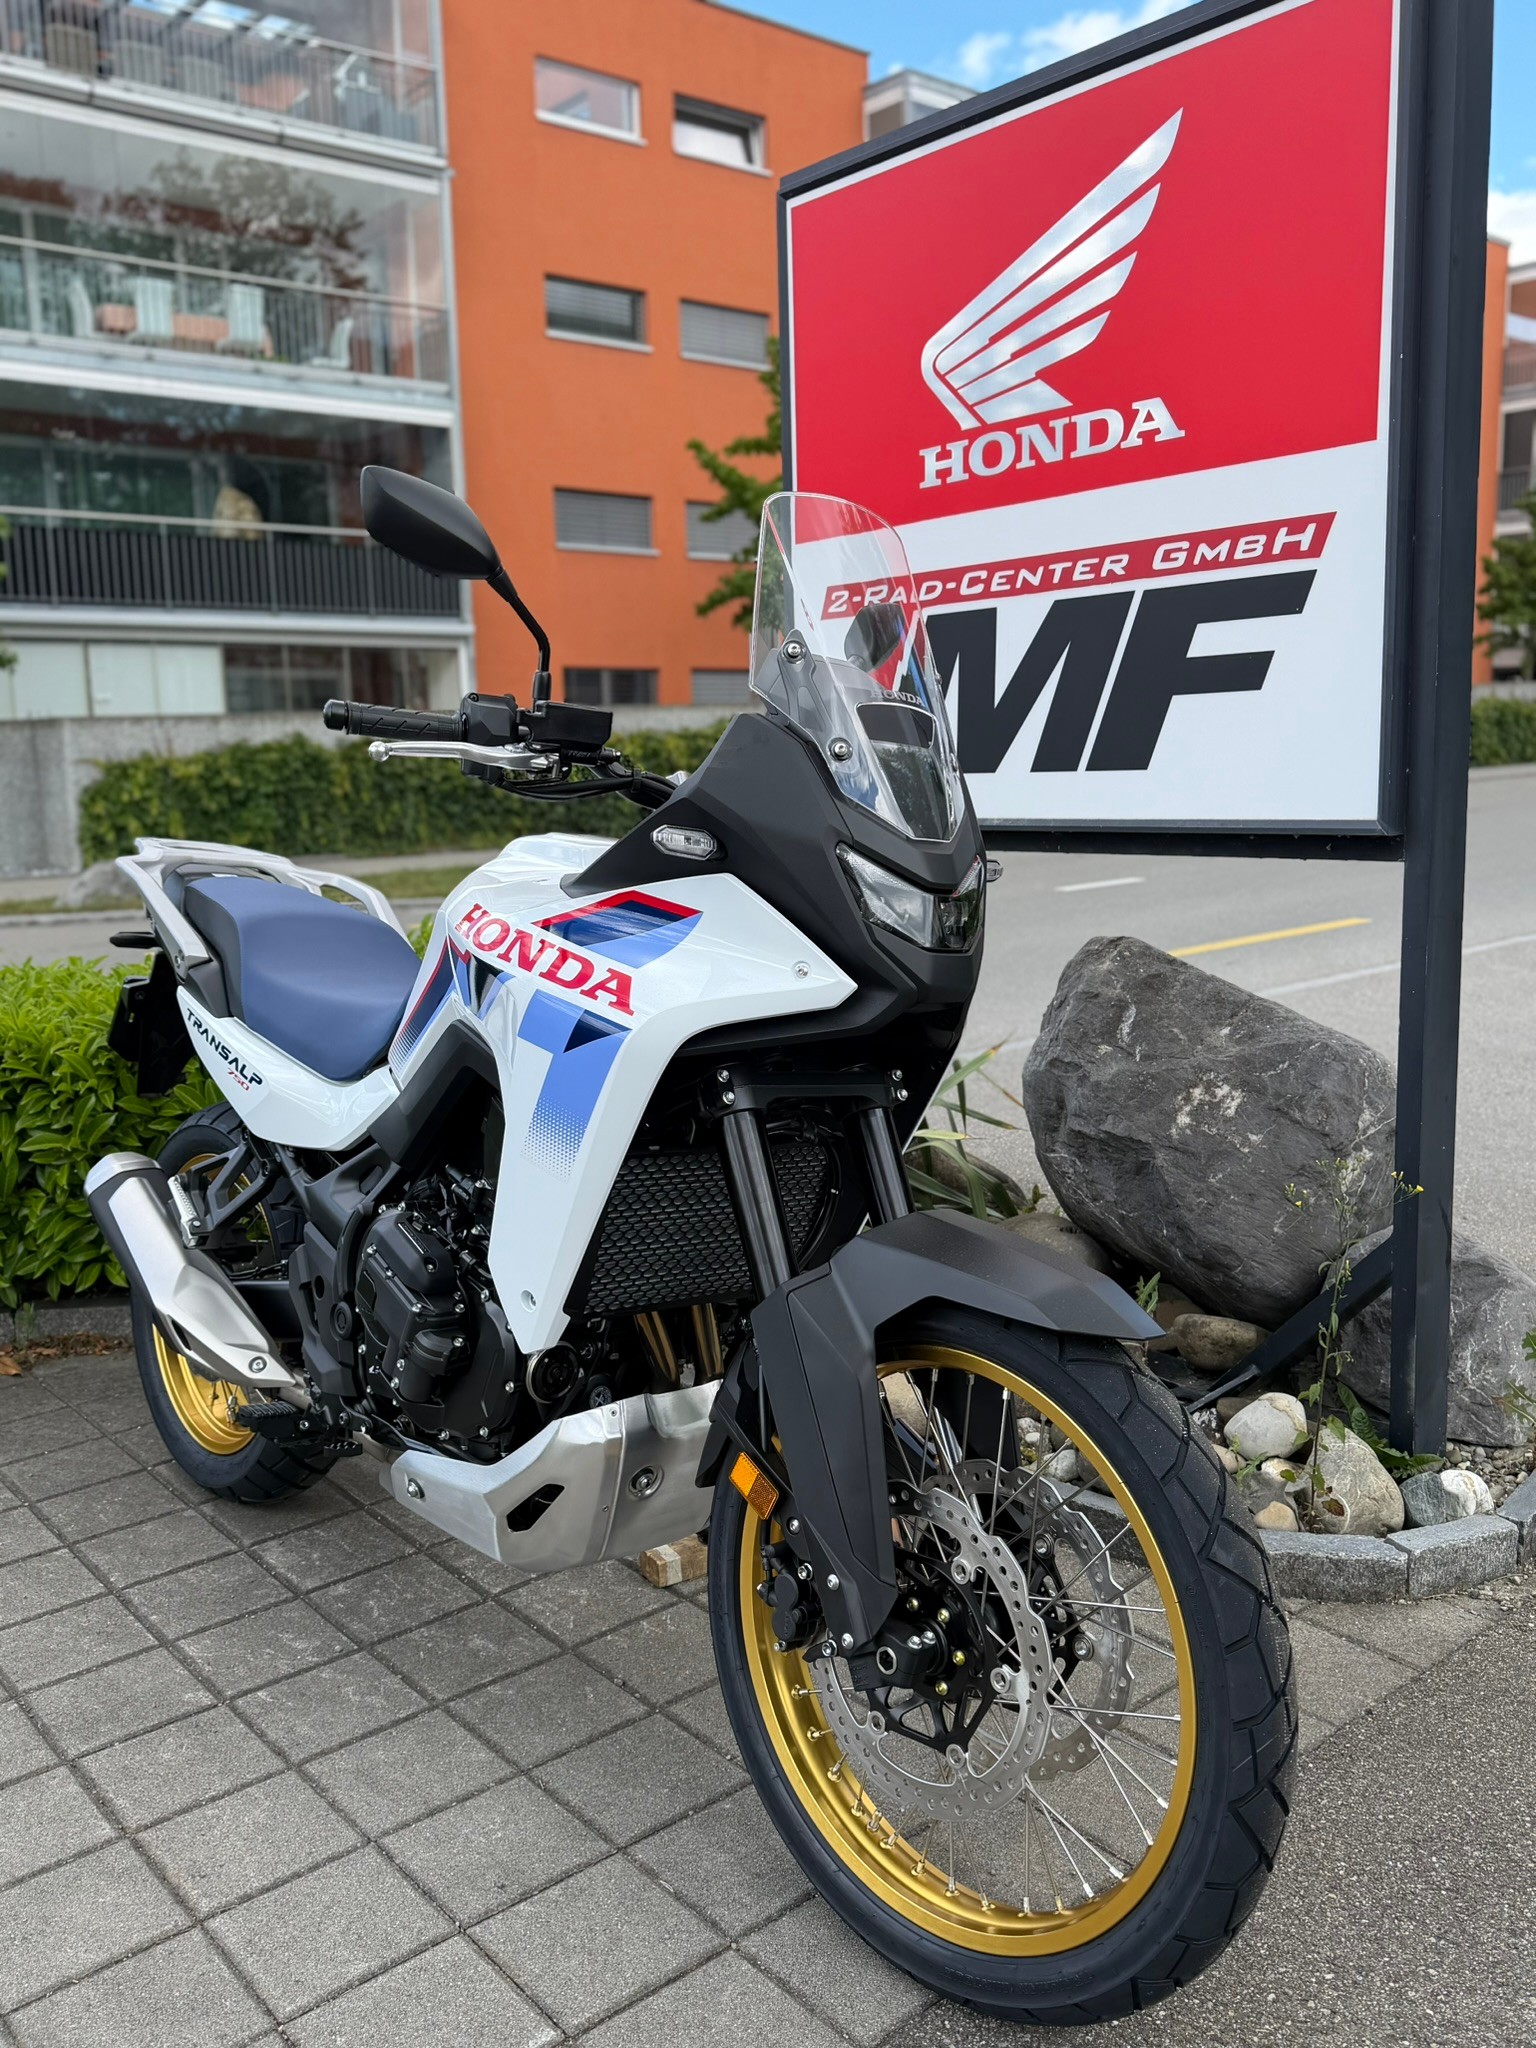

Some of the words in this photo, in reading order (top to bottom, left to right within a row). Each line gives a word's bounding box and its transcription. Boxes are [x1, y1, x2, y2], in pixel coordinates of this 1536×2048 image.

[919, 397, 1185, 489] HONDA
[870, 689, 926, 707] HONDA
[915, 569, 1317, 774] MF
[455, 903, 634, 1016] HONDA
[187, 1008, 263, 1085] TRANSALP
[227, 1068, 250, 1091] 750
